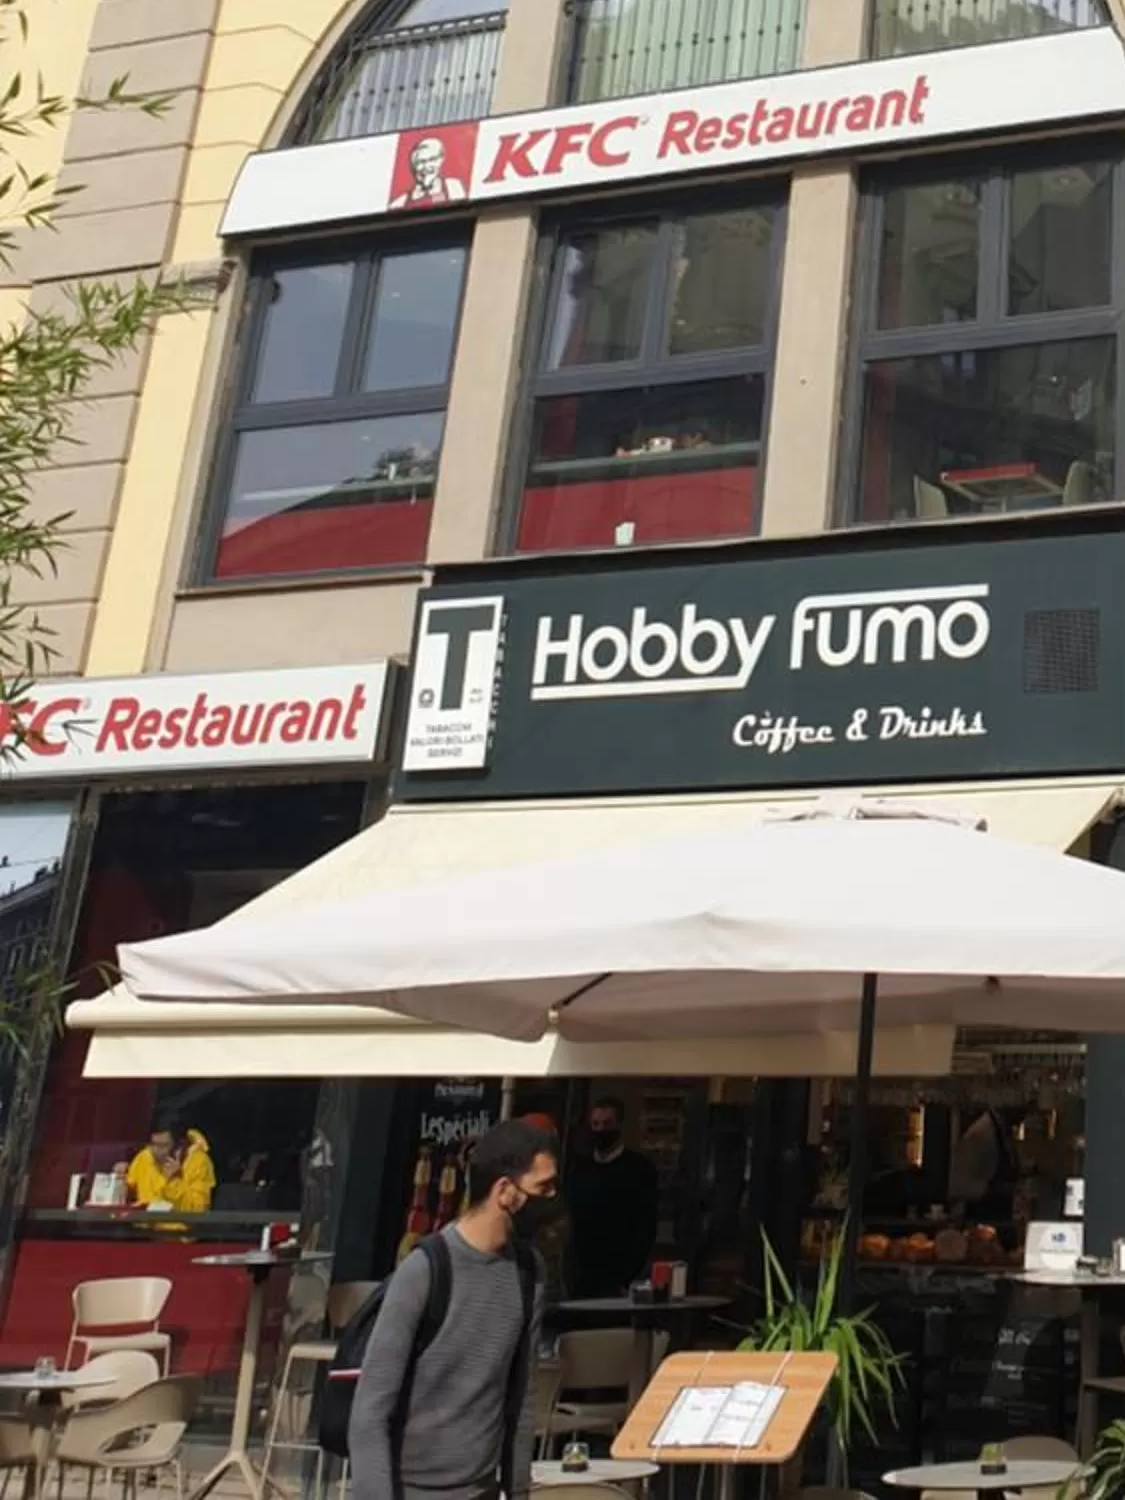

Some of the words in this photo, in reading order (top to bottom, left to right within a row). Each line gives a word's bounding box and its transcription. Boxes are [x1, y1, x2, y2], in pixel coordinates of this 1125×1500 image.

[484, 114, 642, 184] KFC
[656, 74, 930, 159] Restaurant
[426, 604, 496, 712] T
[530, 603, 777, 701] Hobby
[95, 683, 366, 753] Restaurant
[844, 707, 869, 742] &
[878, 706, 988, 740] Drinks
